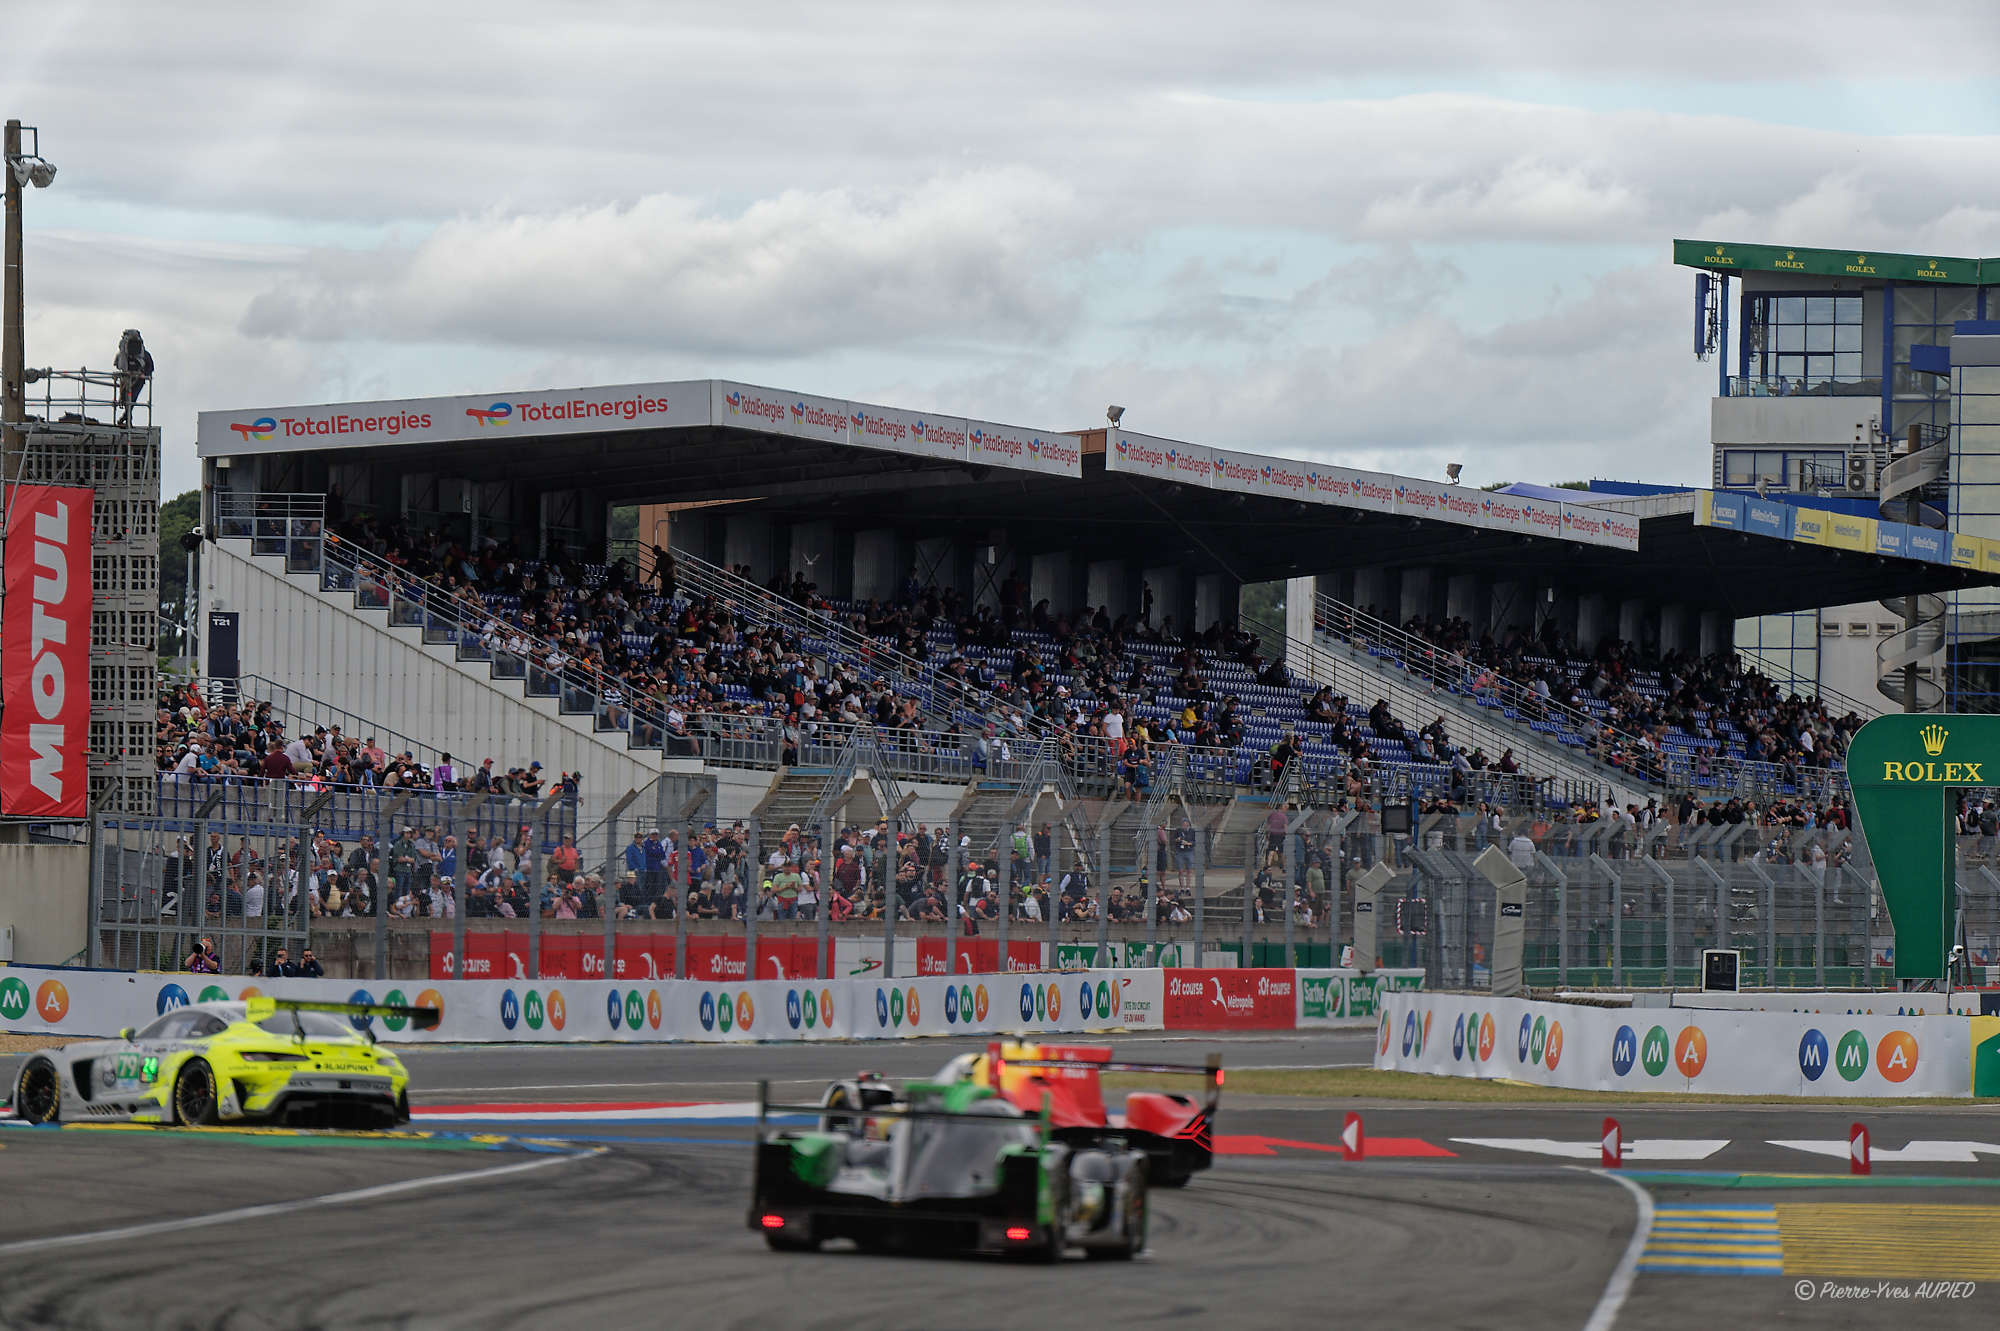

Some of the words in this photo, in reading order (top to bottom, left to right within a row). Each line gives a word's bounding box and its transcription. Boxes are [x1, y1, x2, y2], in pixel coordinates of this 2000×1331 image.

[1704, 255, 1735, 265] ROLEX
[1775, 260, 1805, 269] ROLEX
[1846, 265, 1876, 274] ROLEX
[1917, 269, 1948, 279] ROLEX
[516, 395, 668, 422] TotalEnergies
[741, 395, 785, 423] TotalEnergies
[804, 403, 847, 432] TotalEnergies
[280, 411, 432, 437] TotalEnergies
[864, 414, 906, 441] TotalEnergies
[924, 423, 965, 448] TotalEnergies
[983, 432, 1022, 456] TotalEnergies
[1040, 440, 1078, 465] TotalEnergies
[1127, 443, 1163, 468] TotalEnergies
[1176, 452, 1211, 477] TotalEnergies
[1225, 461, 1258, 484] TotalEnergies
[1271, 468, 1304, 491] TotalEnergies
[1317, 474, 1349, 497] TotalEnergies
[1361, 481, 1392, 504] TotalEnergies
[1405, 488, 1436, 511] TotalEnergies
[1448, 495, 1478, 517] TotalEnergies
[1491, 502, 1520, 523] TotalEnergies
[1532, 508, 1560, 530] TotalEnergies
[1572, 514, 1600, 536] TotalEnergies
[212, 618, 231, 626] T21
[29, 499, 69, 804] MOTUL
[1882, 761, 1984, 782] ROLEX
[1181, 982, 1203, 995] course
[1270, 982, 1291, 995] course
[1304, 981, 1325, 1002] Sarthe
[1351, 982, 1372, 1001] Sarthe
[119, 1054, 137, 1077] 79
